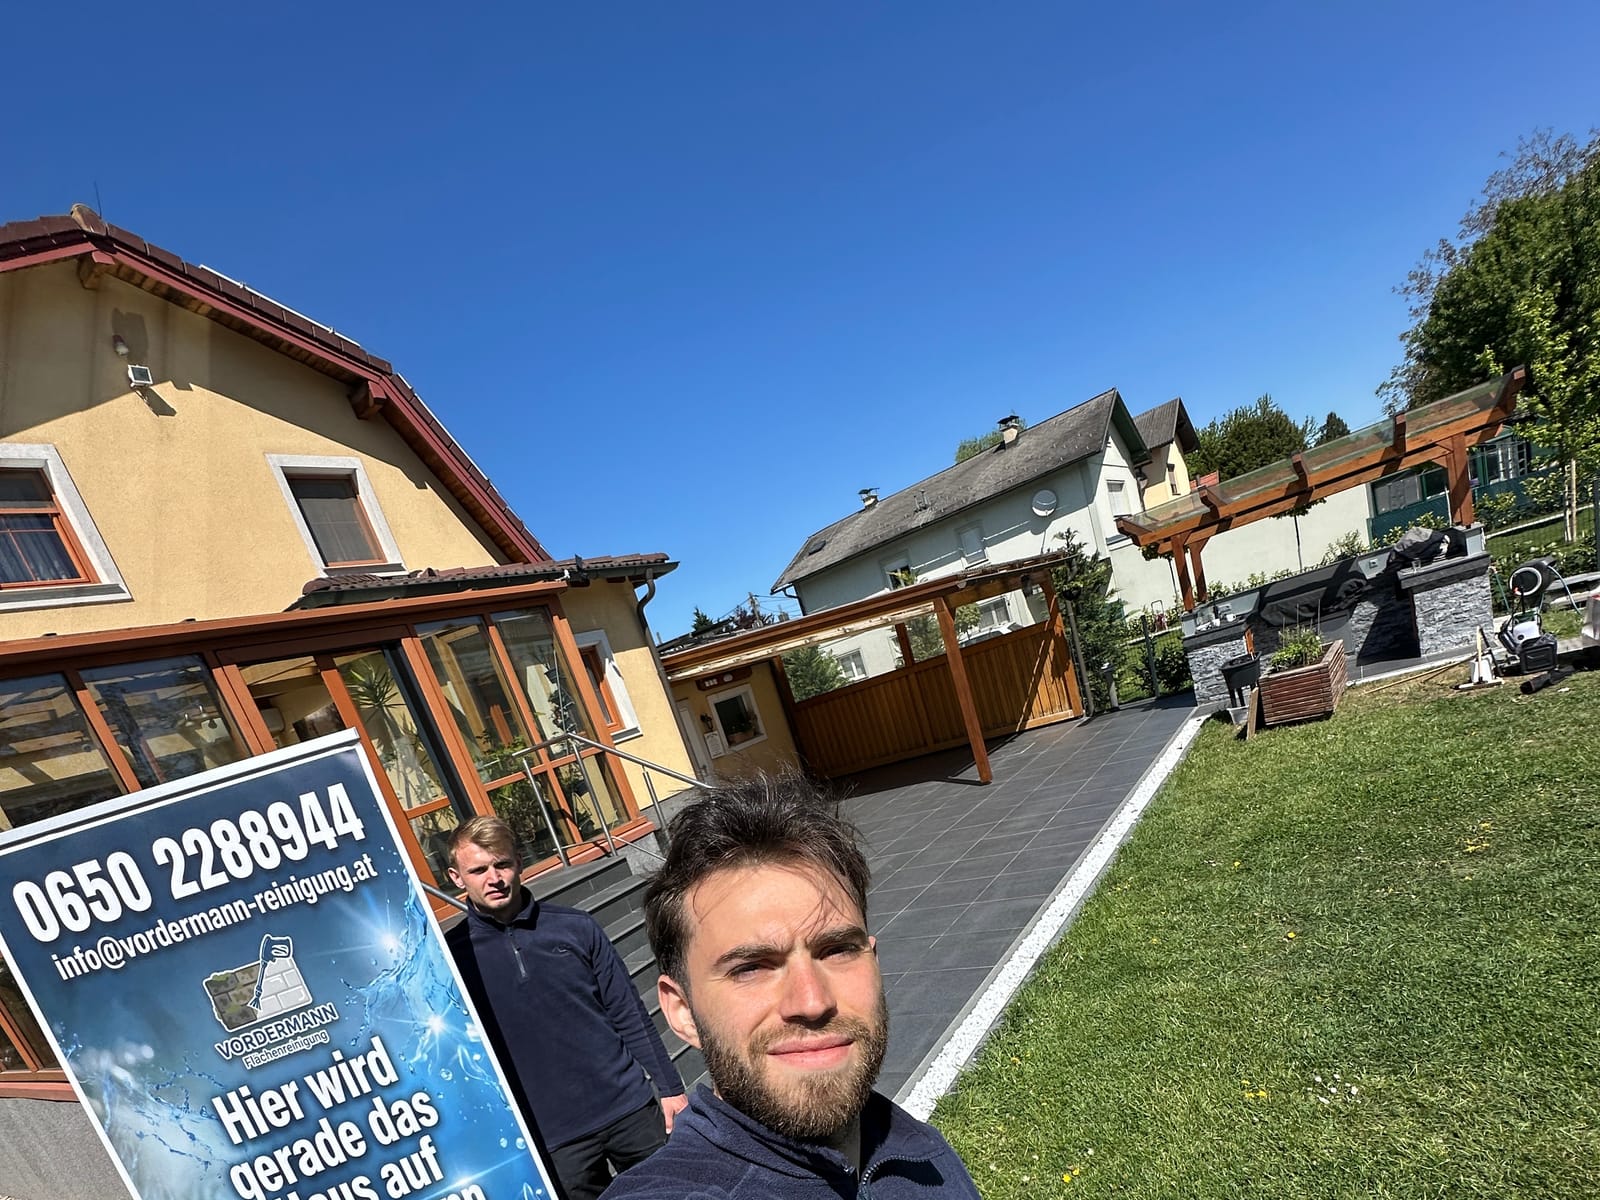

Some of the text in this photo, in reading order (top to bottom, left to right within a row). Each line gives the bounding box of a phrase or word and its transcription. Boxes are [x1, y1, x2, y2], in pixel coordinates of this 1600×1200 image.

[12, 782, 366, 942] 0650 2288944
[51, 853, 379, 981] info@vordermann-reinigung.at
[215, 1003, 338, 1059] VORDERMANN
[243, 1030, 329, 1069] Flächenreinigung
[211, 1035, 399, 1145] Hier wird
[229, 1091, 439, 1200] gerade das
[380, 1135, 445, 1199] auf
